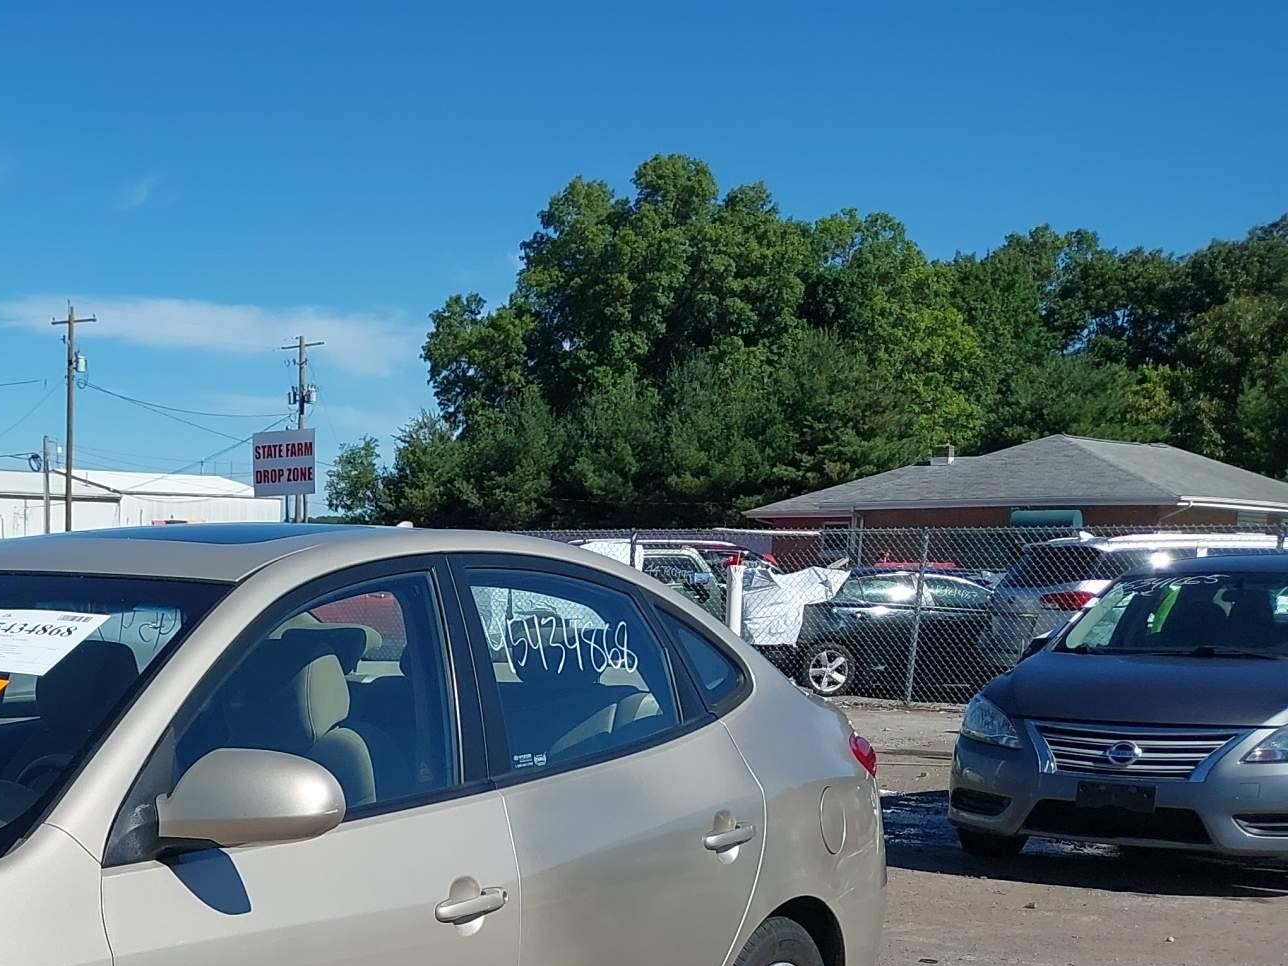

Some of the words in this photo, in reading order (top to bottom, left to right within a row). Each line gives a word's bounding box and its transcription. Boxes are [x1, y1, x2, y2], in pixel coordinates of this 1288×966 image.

[255, 443, 284, 460] STATE
[285, 441, 313, 458] FARM
[255, 468, 284, 484] DROP
[286, 466, 313, 482] ZONE
[480, 614, 639, 674] 45434868
